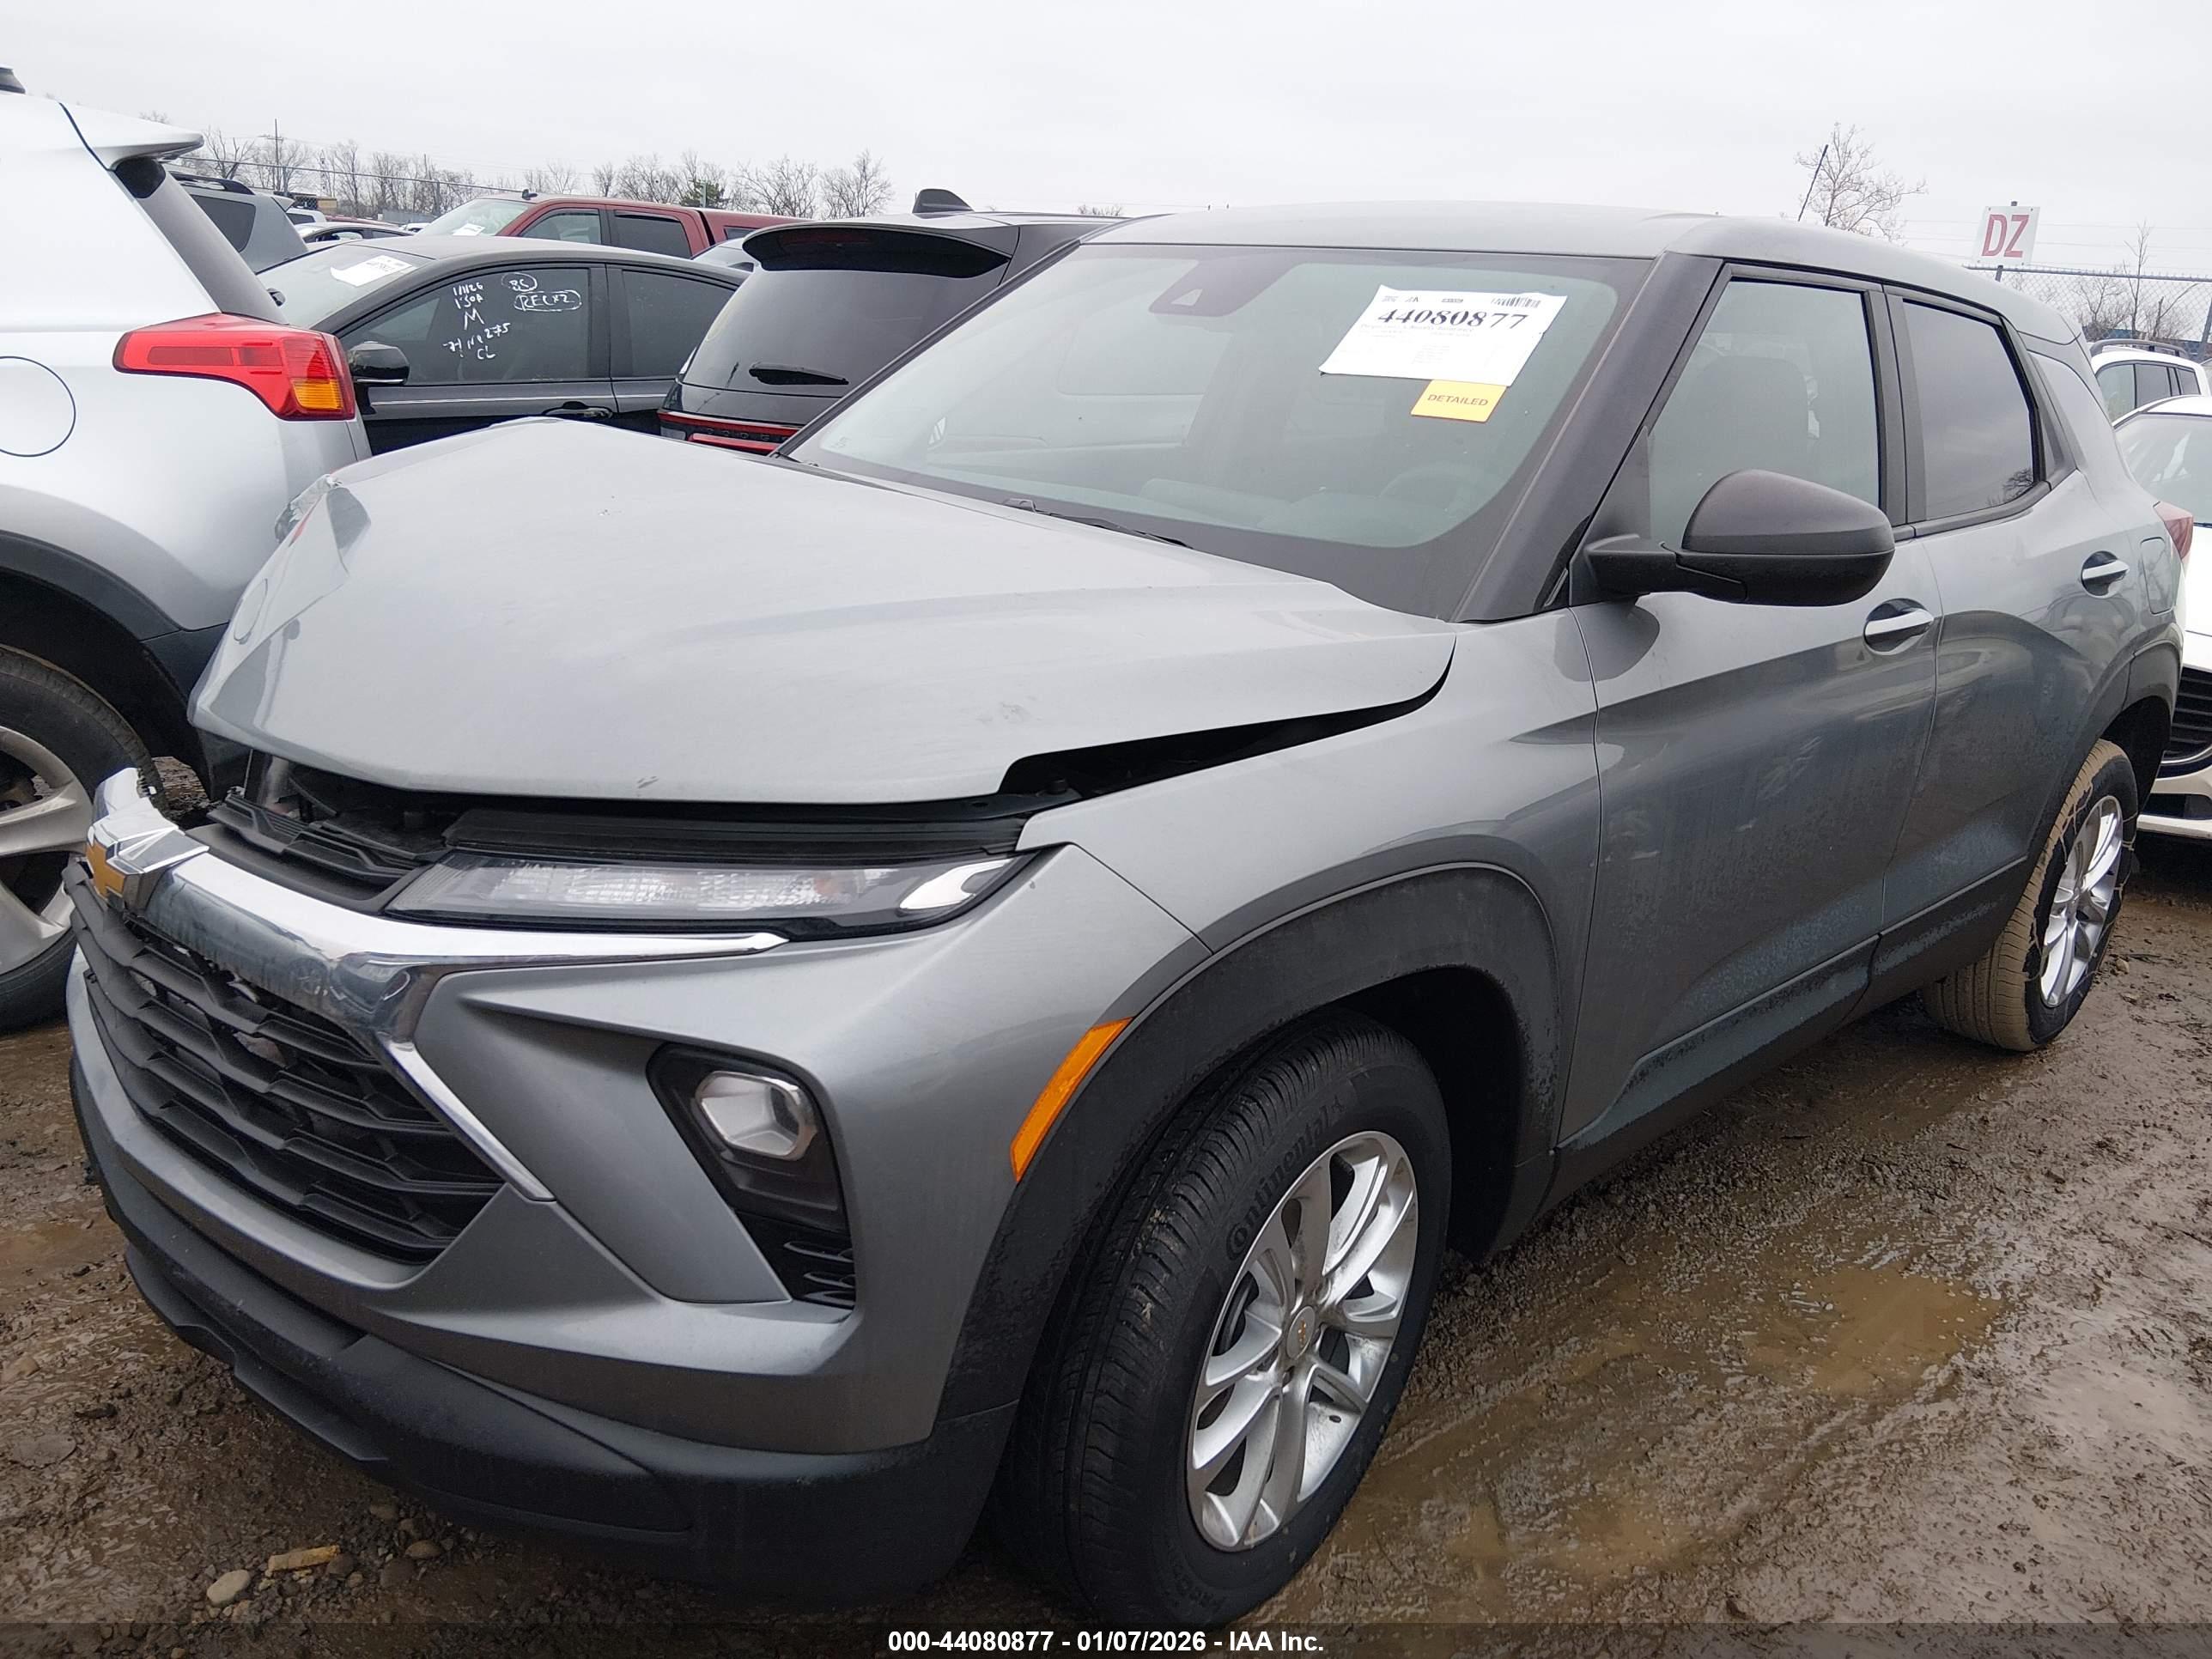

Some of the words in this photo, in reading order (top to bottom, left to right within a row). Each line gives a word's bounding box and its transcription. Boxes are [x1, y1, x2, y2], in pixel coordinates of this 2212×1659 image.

[1981, 214, 2030, 258] DZ
[464, 307, 485, 331] M
[1377, 308, 1529, 330] 44080877
[1426, 393, 1489, 407] DETAILED
